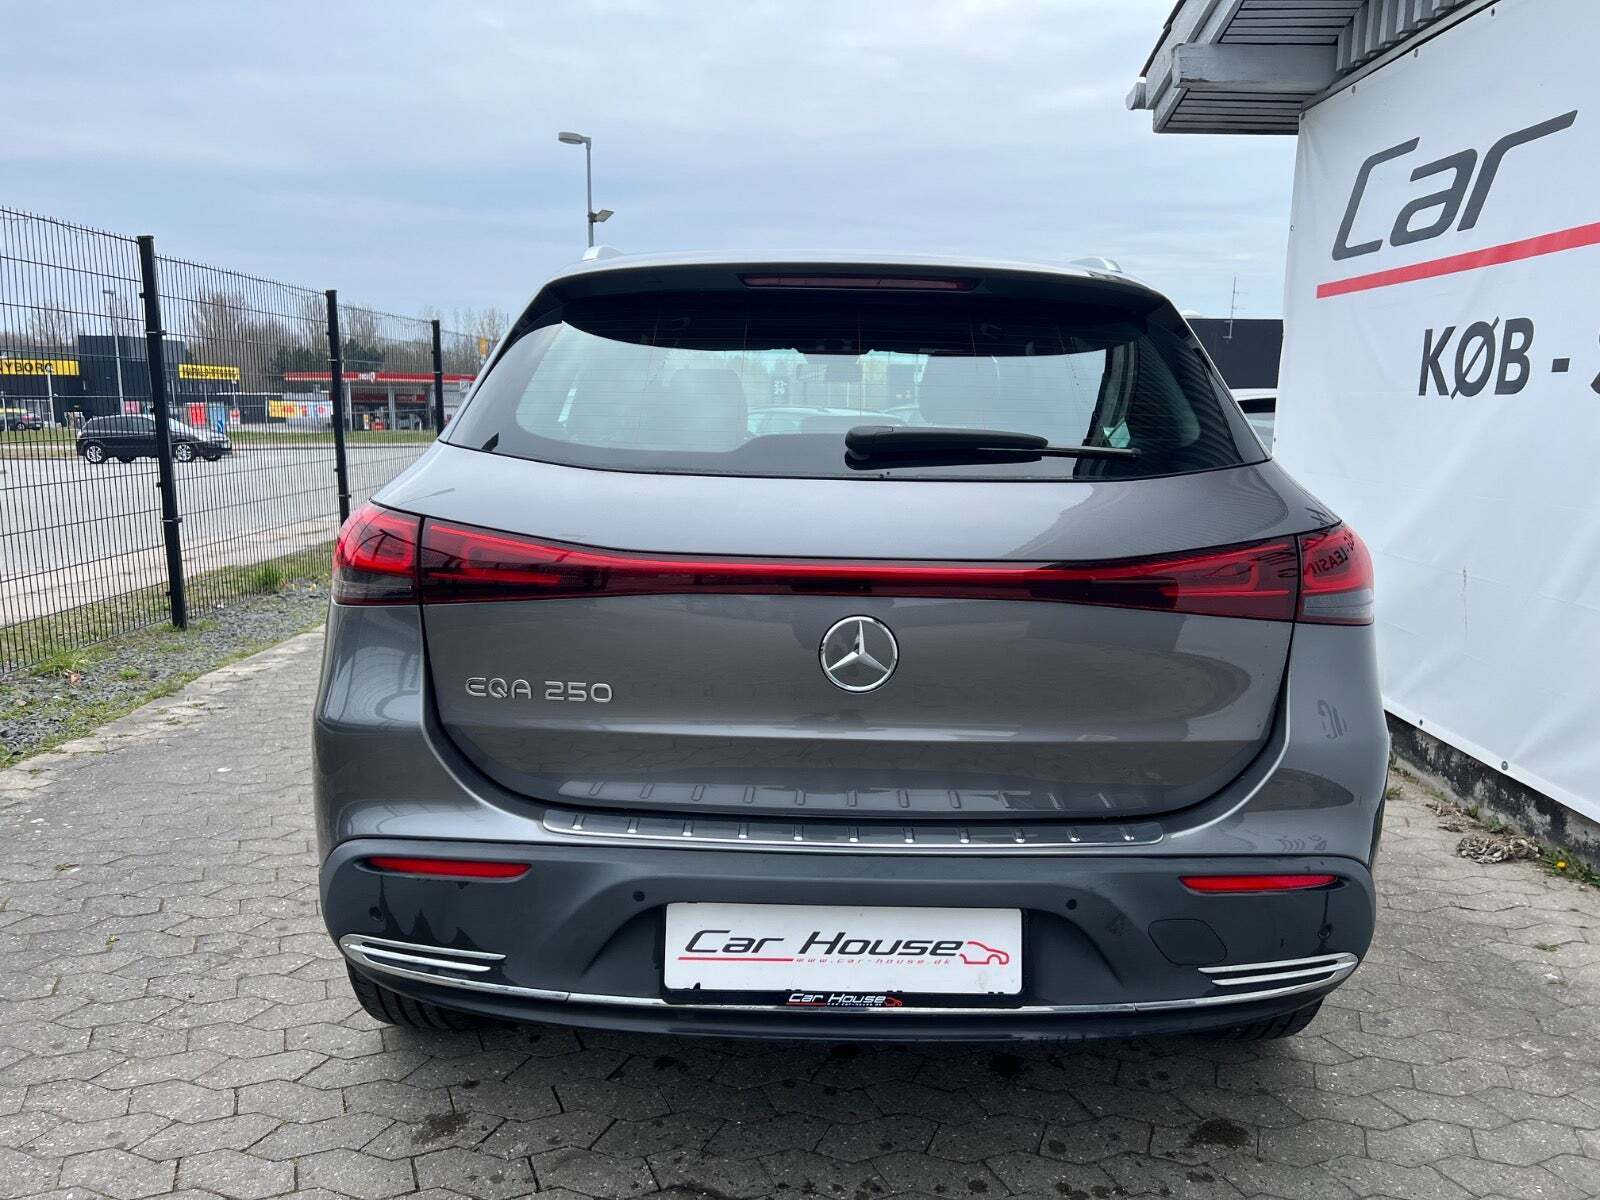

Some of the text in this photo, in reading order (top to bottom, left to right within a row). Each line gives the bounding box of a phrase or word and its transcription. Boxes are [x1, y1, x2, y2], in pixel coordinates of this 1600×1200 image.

[1332, 110, 1578, 261] Car
[0, 362, 55, 373] YBORG
[1418, 316, 1535, 400] KØB
[465, 677, 613, 703] EQA 250
[685, 929, 965, 957] Car House
[796, 957, 950, 965] www.car-house.dk
[788, 993, 887, 1003] Car House
